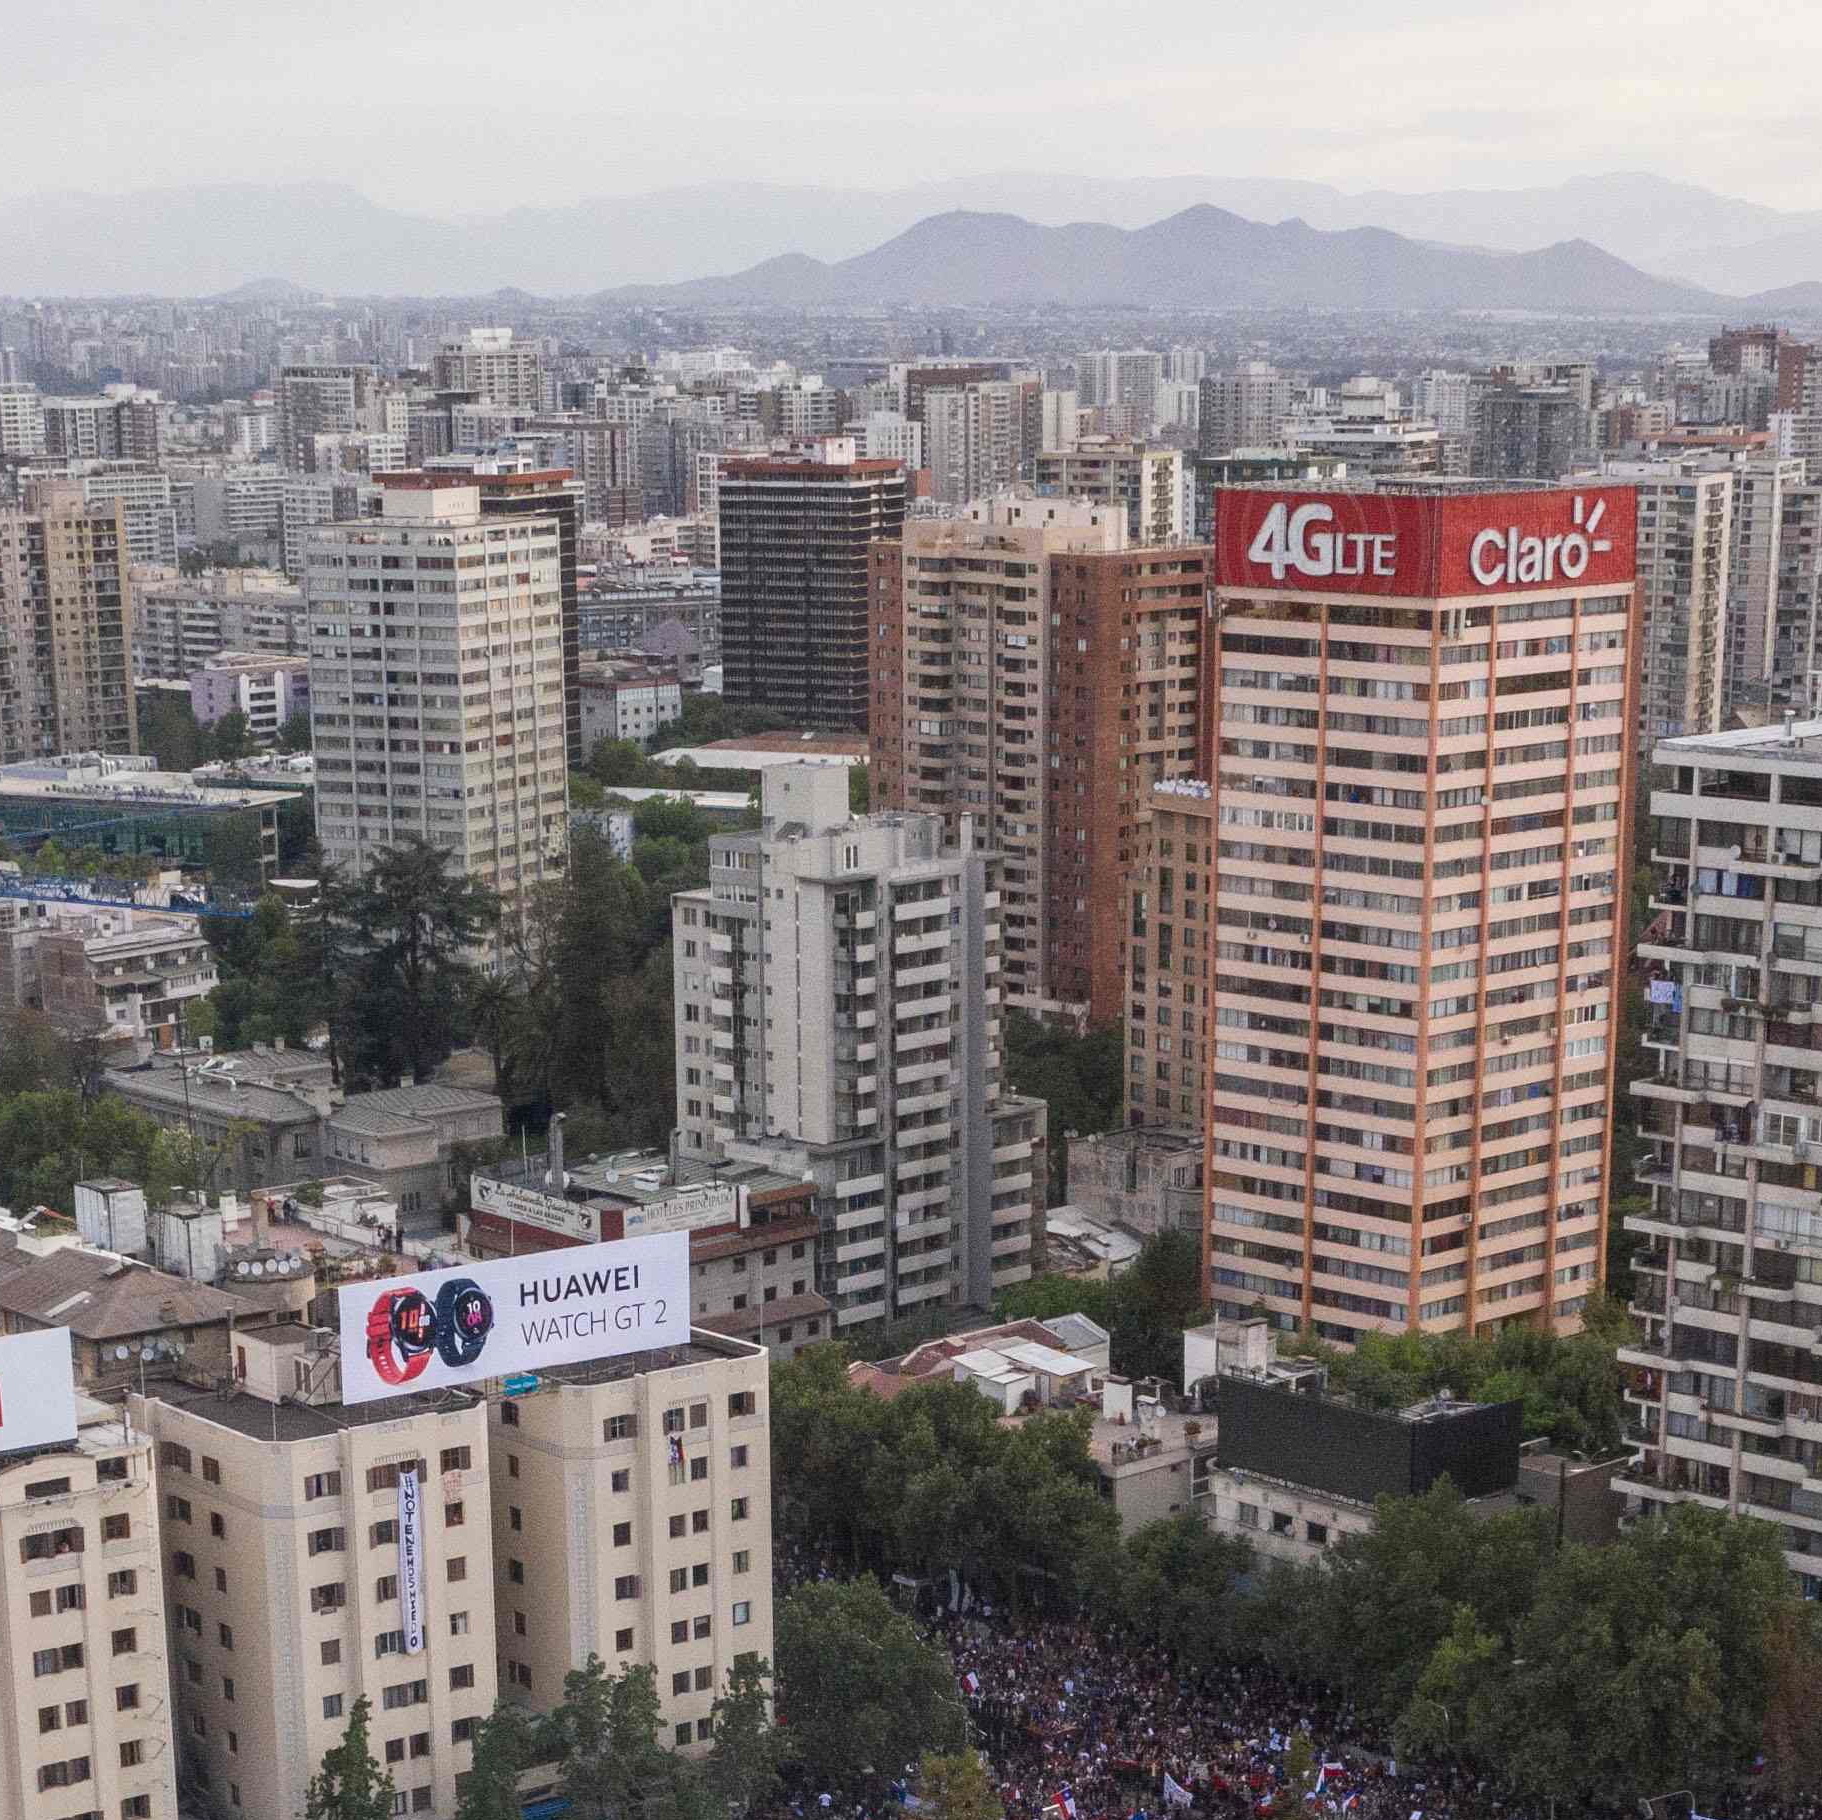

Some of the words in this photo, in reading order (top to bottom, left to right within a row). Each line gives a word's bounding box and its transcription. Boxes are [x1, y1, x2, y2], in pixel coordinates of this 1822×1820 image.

[1335, 533, 1396, 576] LTE
[1470, 526, 1588, 586] Claro
[520, 1264, 639, 1307] HUAWEI
[521, 1307, 607, 1346] WATCH
[614, 1302, 645, 1331] GT
[654, 1299, 668, 1325] 2
